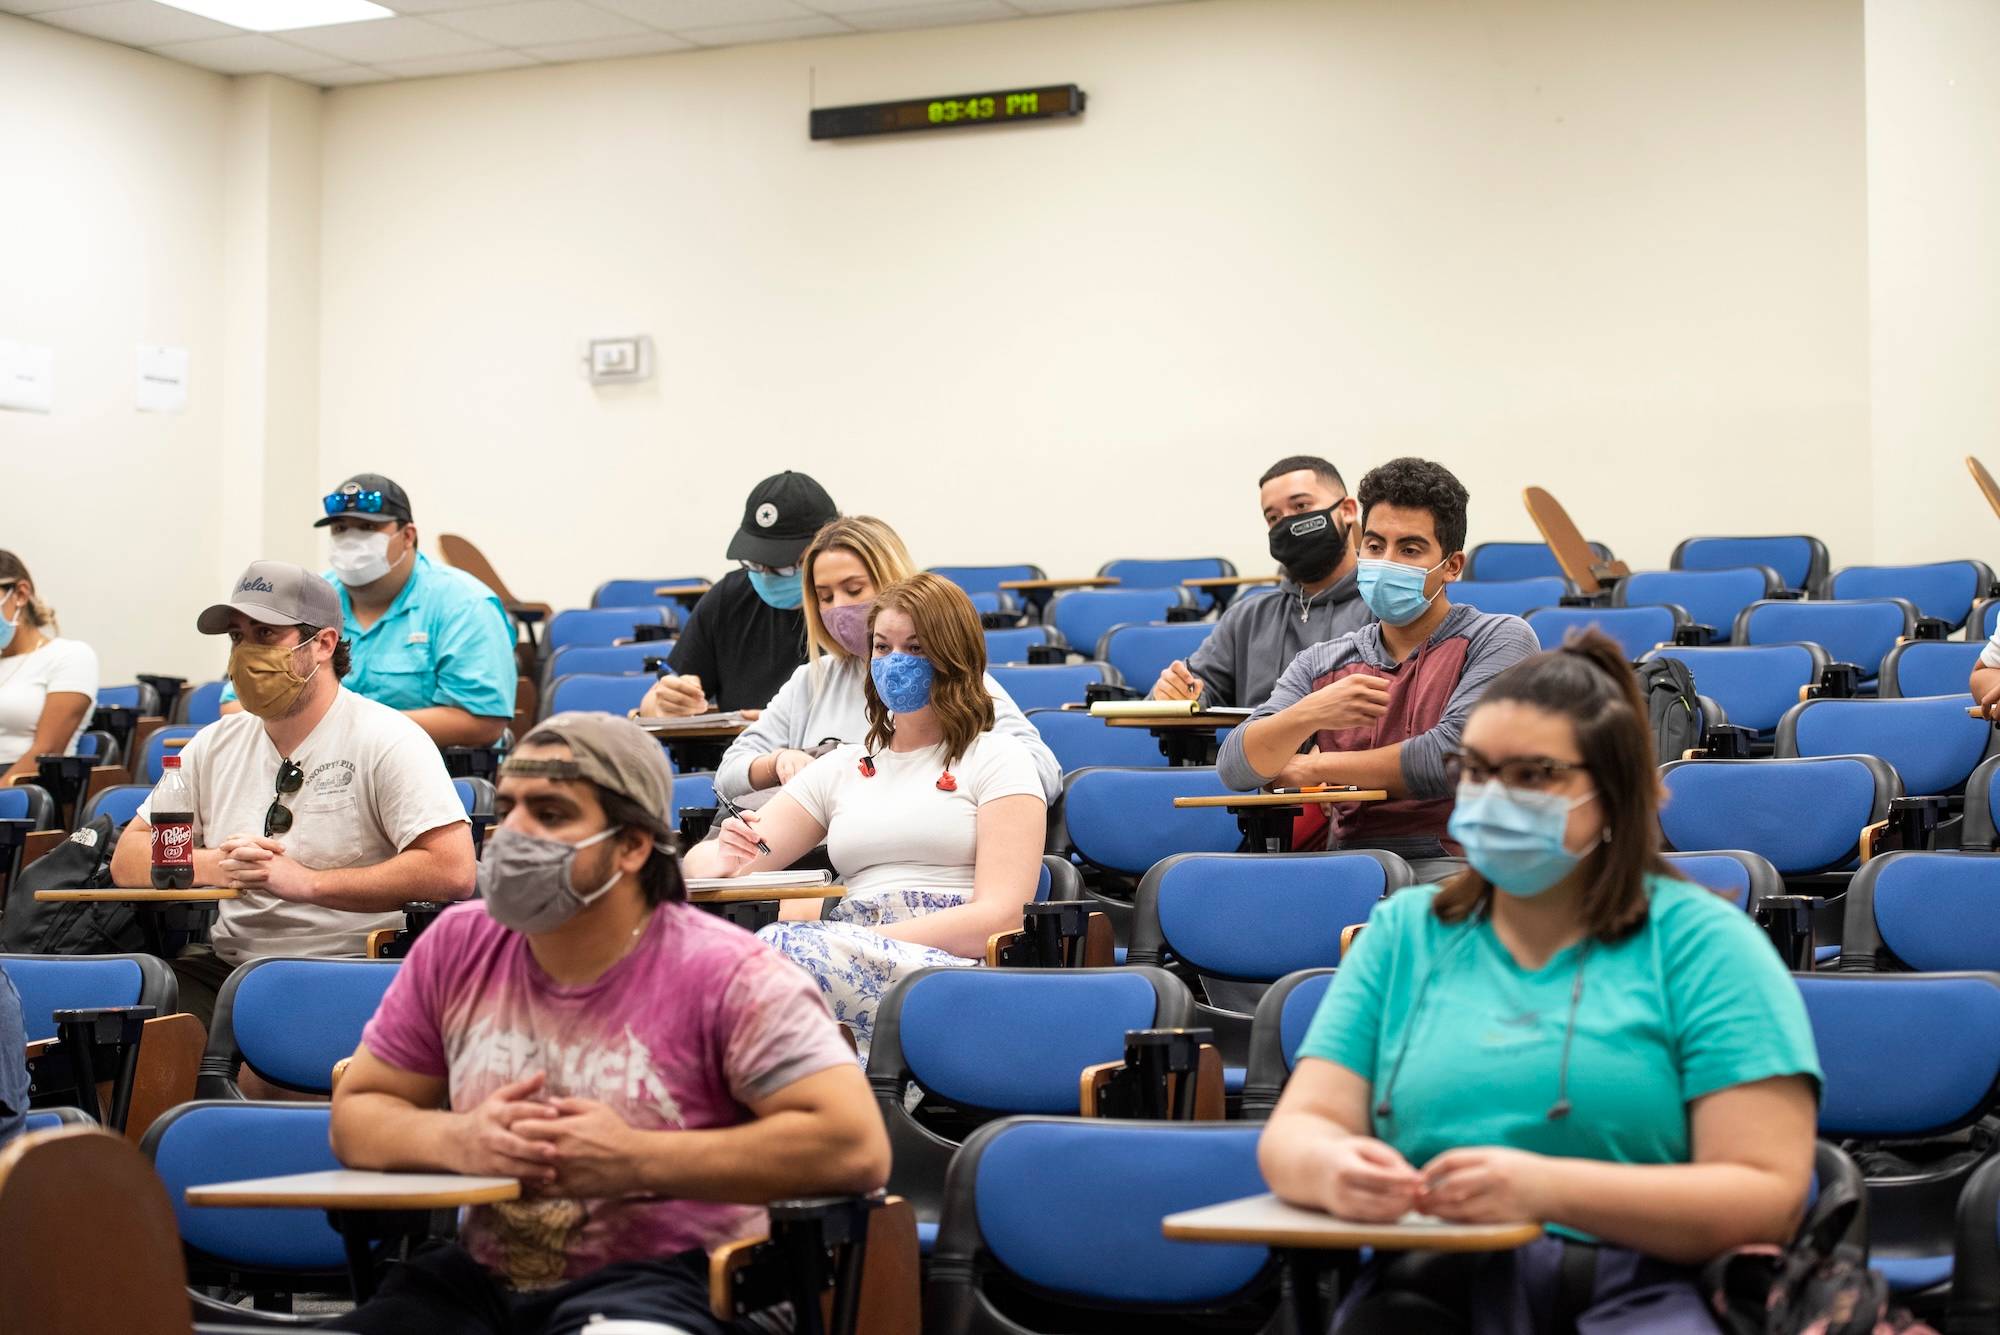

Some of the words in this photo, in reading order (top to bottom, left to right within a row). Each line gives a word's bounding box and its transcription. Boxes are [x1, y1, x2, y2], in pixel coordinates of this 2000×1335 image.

[927, 97, 995, 124] 03:43
[1005, 92, 1039, 116] PM
[238, 576, 273, 593] bela's
[161, 828, 191, 847] Pepper
[172, 826, 185, 837] Dr
